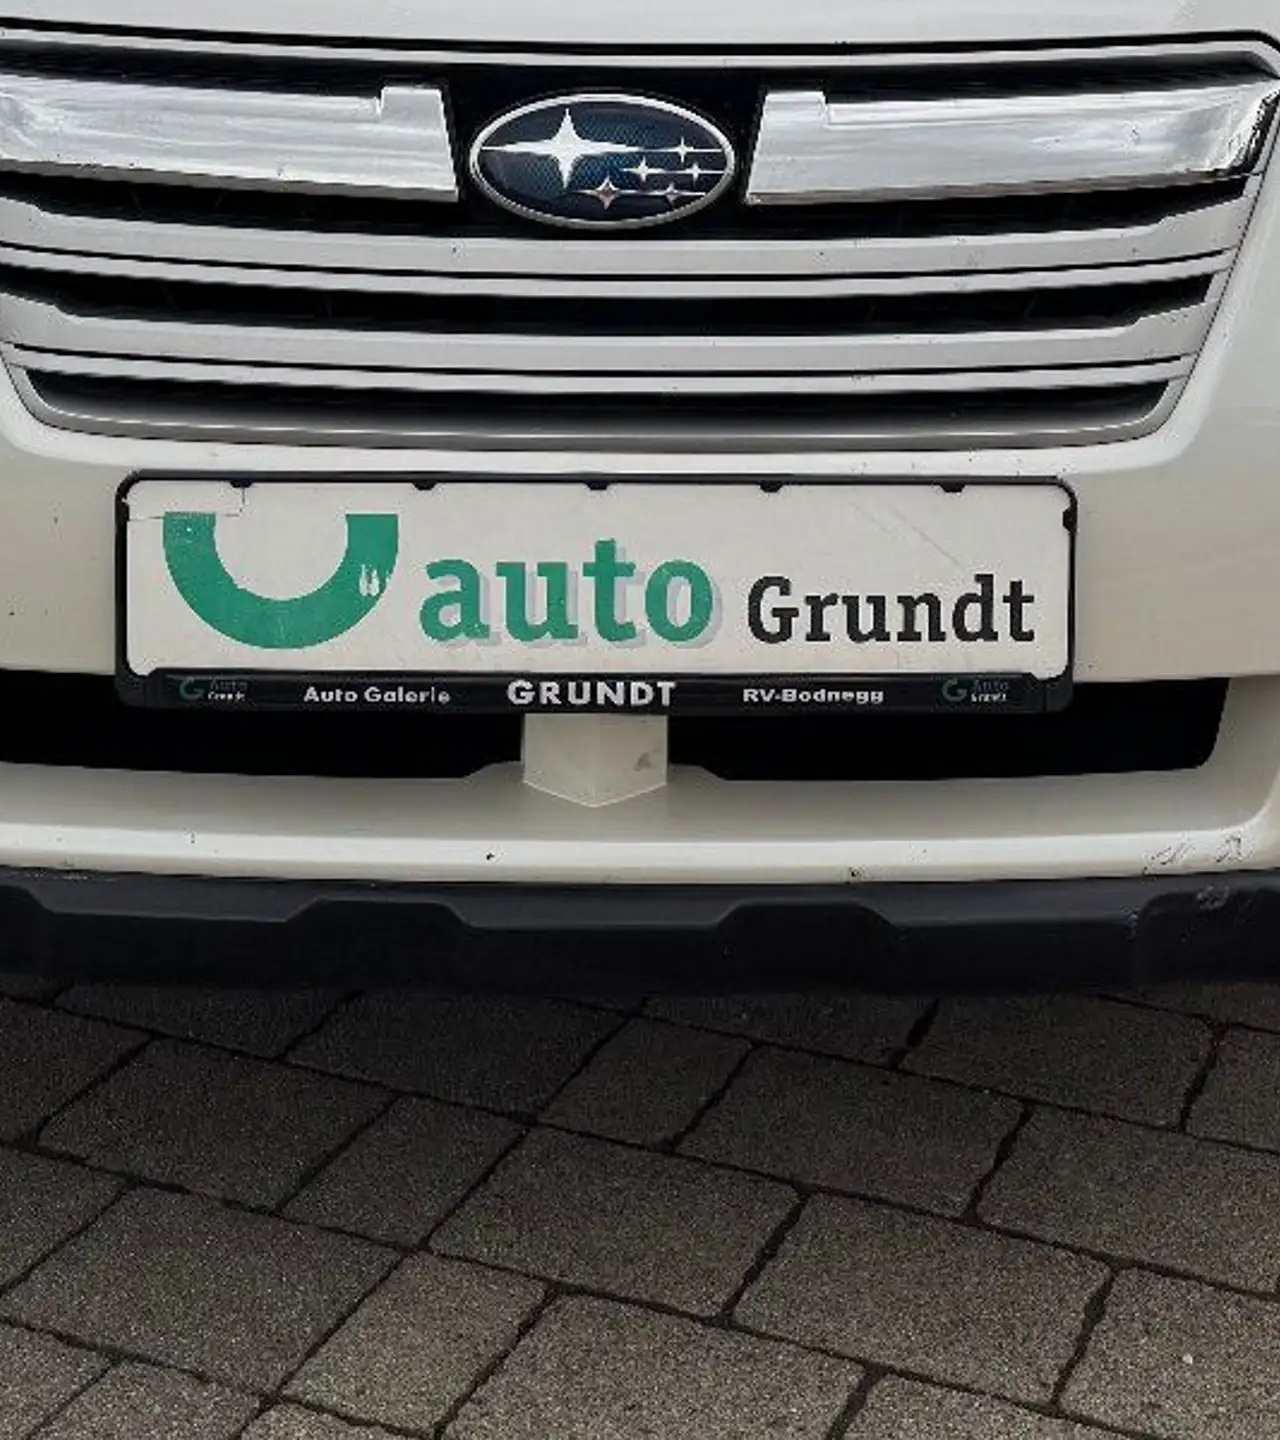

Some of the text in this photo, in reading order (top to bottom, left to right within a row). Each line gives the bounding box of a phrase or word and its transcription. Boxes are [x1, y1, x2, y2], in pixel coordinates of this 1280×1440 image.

[419, 537, 1035, 646] auto Grundt
[303, 678, 884, 707] Auto Galerie GRUNDT RV-Bodnegg
